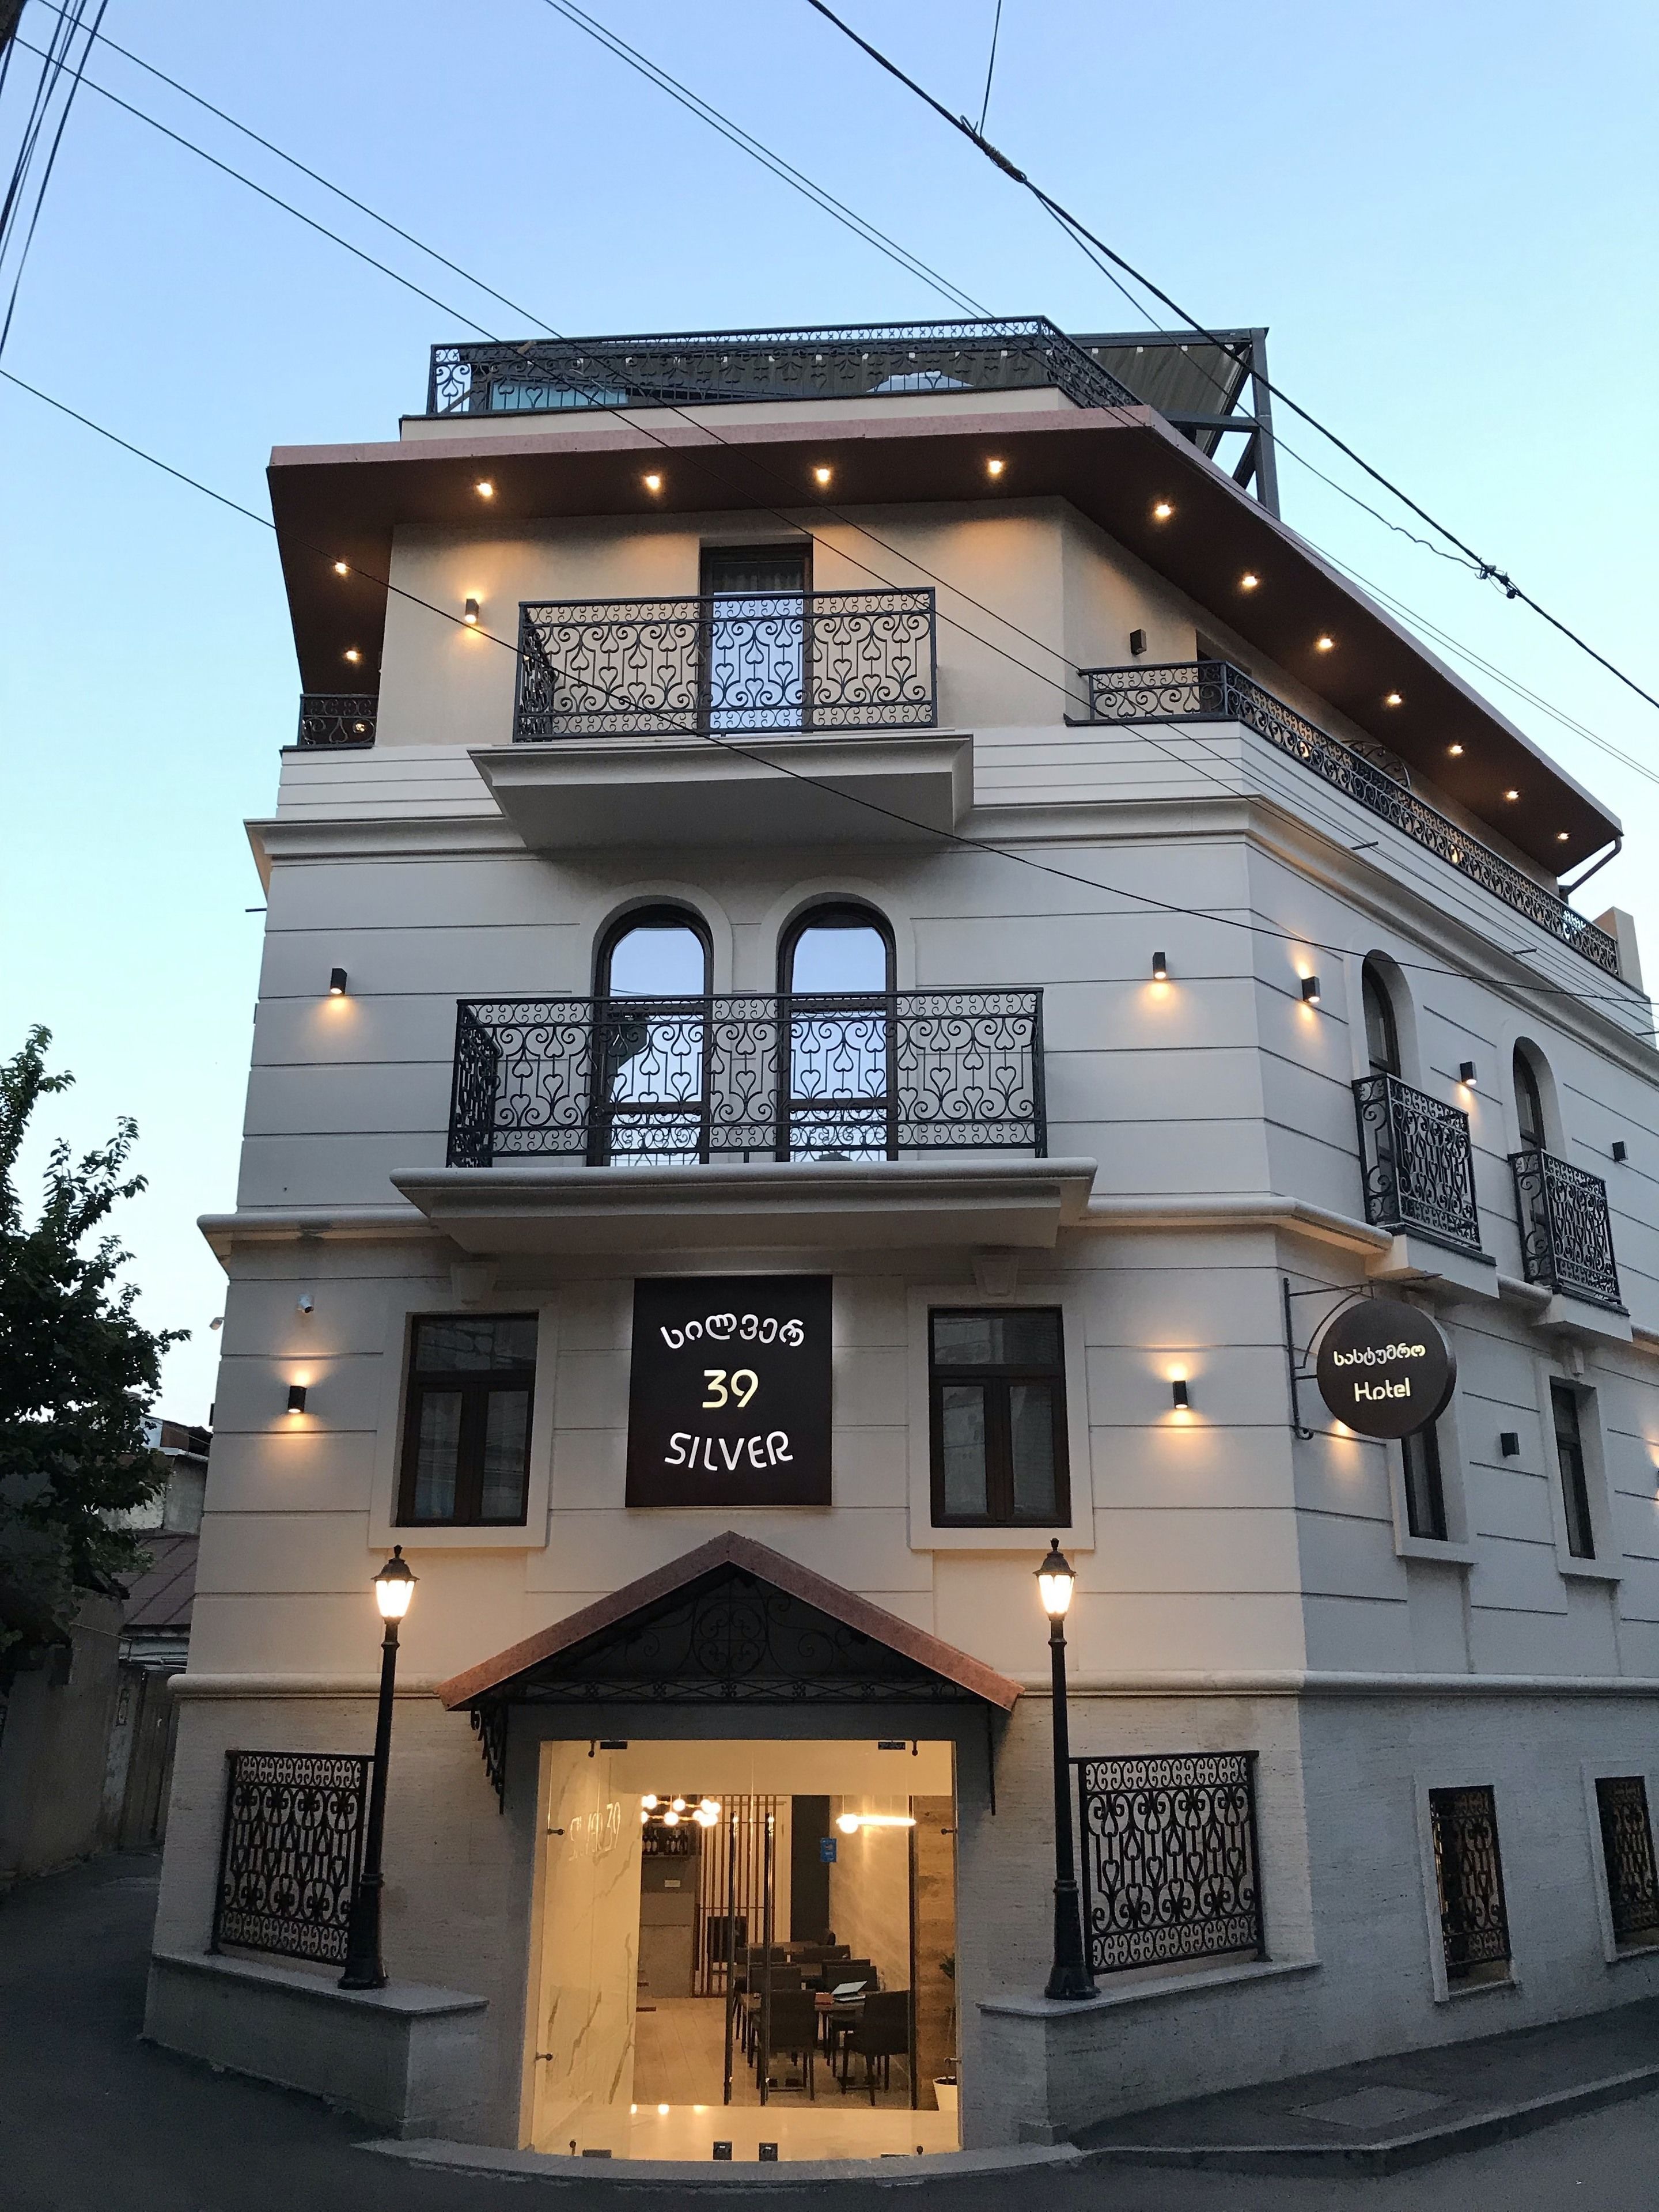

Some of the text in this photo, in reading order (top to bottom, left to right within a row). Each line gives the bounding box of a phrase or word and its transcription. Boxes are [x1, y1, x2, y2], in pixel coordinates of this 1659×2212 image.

[660, 1313, 804, 1349] სილვერ
[1334, 1342, 1426, 1366] სასტუმრო
[702, 1369, 759, 1408] 39
[1354, 1377, 1411, 1402] Hotel
[664, 1431, 793, 1471] SILVER
[606, 1801, 621, 1852] 39
